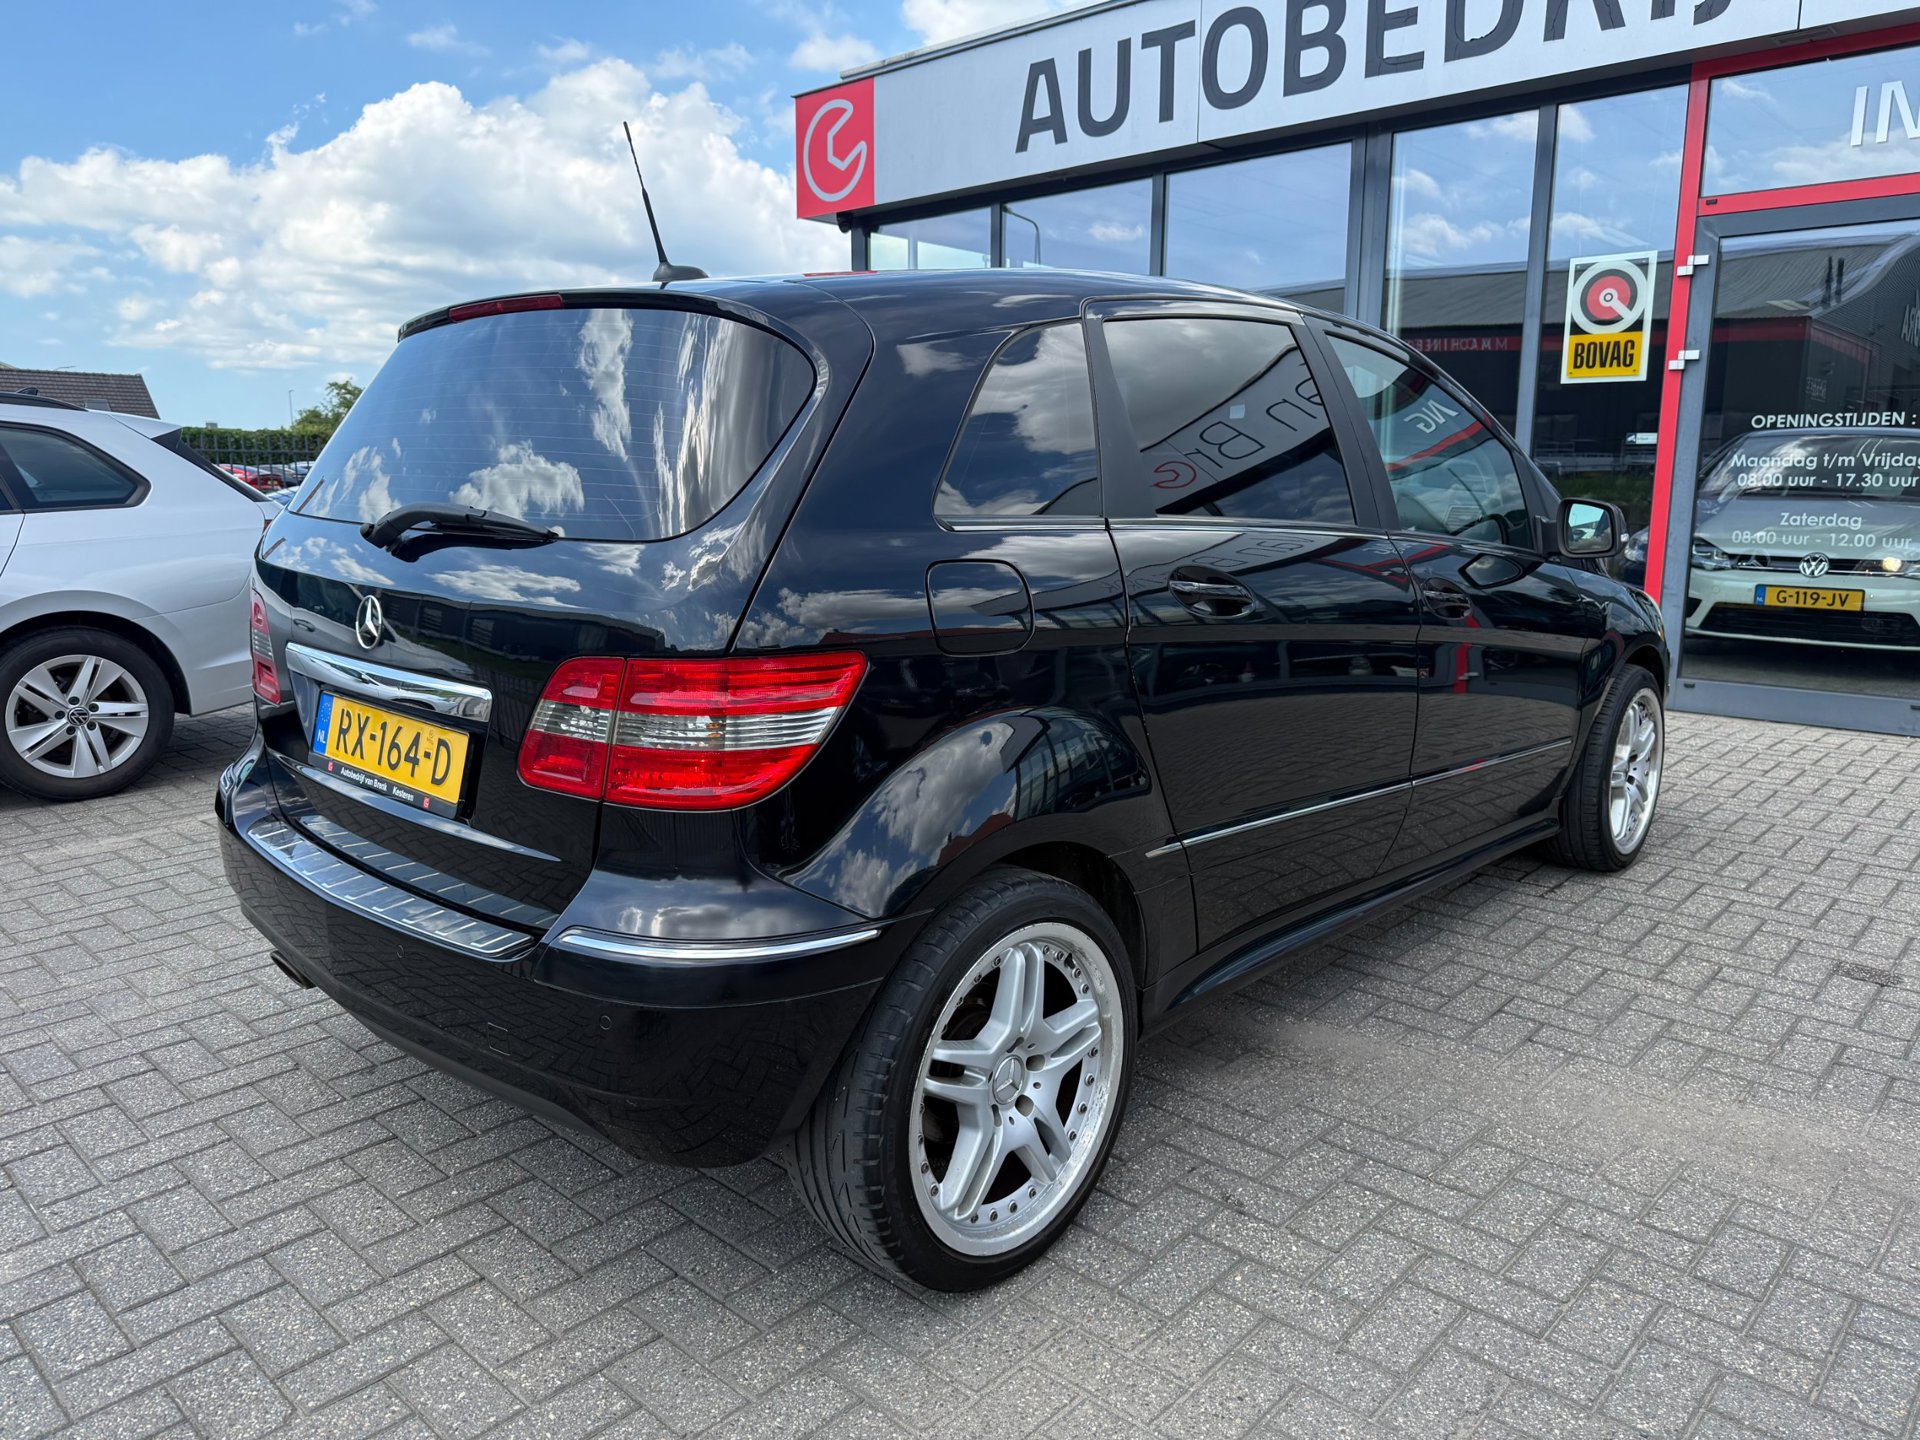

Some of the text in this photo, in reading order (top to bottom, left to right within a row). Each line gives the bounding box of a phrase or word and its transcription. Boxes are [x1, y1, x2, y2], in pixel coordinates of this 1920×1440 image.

[1015, 0, 1732, 153] AUTOBED
[1573, 339, 1635, 369] BOVAG
[1751, 411, 1906, 429] OPENINGSTIJDEN
[1731, 453, 1818, 470] Maandag
[1823, 453, 1855, 469] t/m
[1737, 473, 1783, 487] 08.00
[1788, 476, 1816, 487] uur
[1836, 473, 1883, 487] 17.30
[1889, 475, 1920, 487] uur
[1780, 512, 1863, 530] Zaterdag
[1782, 533, 1810, 545] uur
[1830, 533, 1876, 548] 12.00
[1882, 536, 1912, 549] uur
[1776, 589, 1850, 608] G-119-JV
[336, 708, 453, 786] RX-164-D
[341, 767, 365, 784] Autobedrijf
